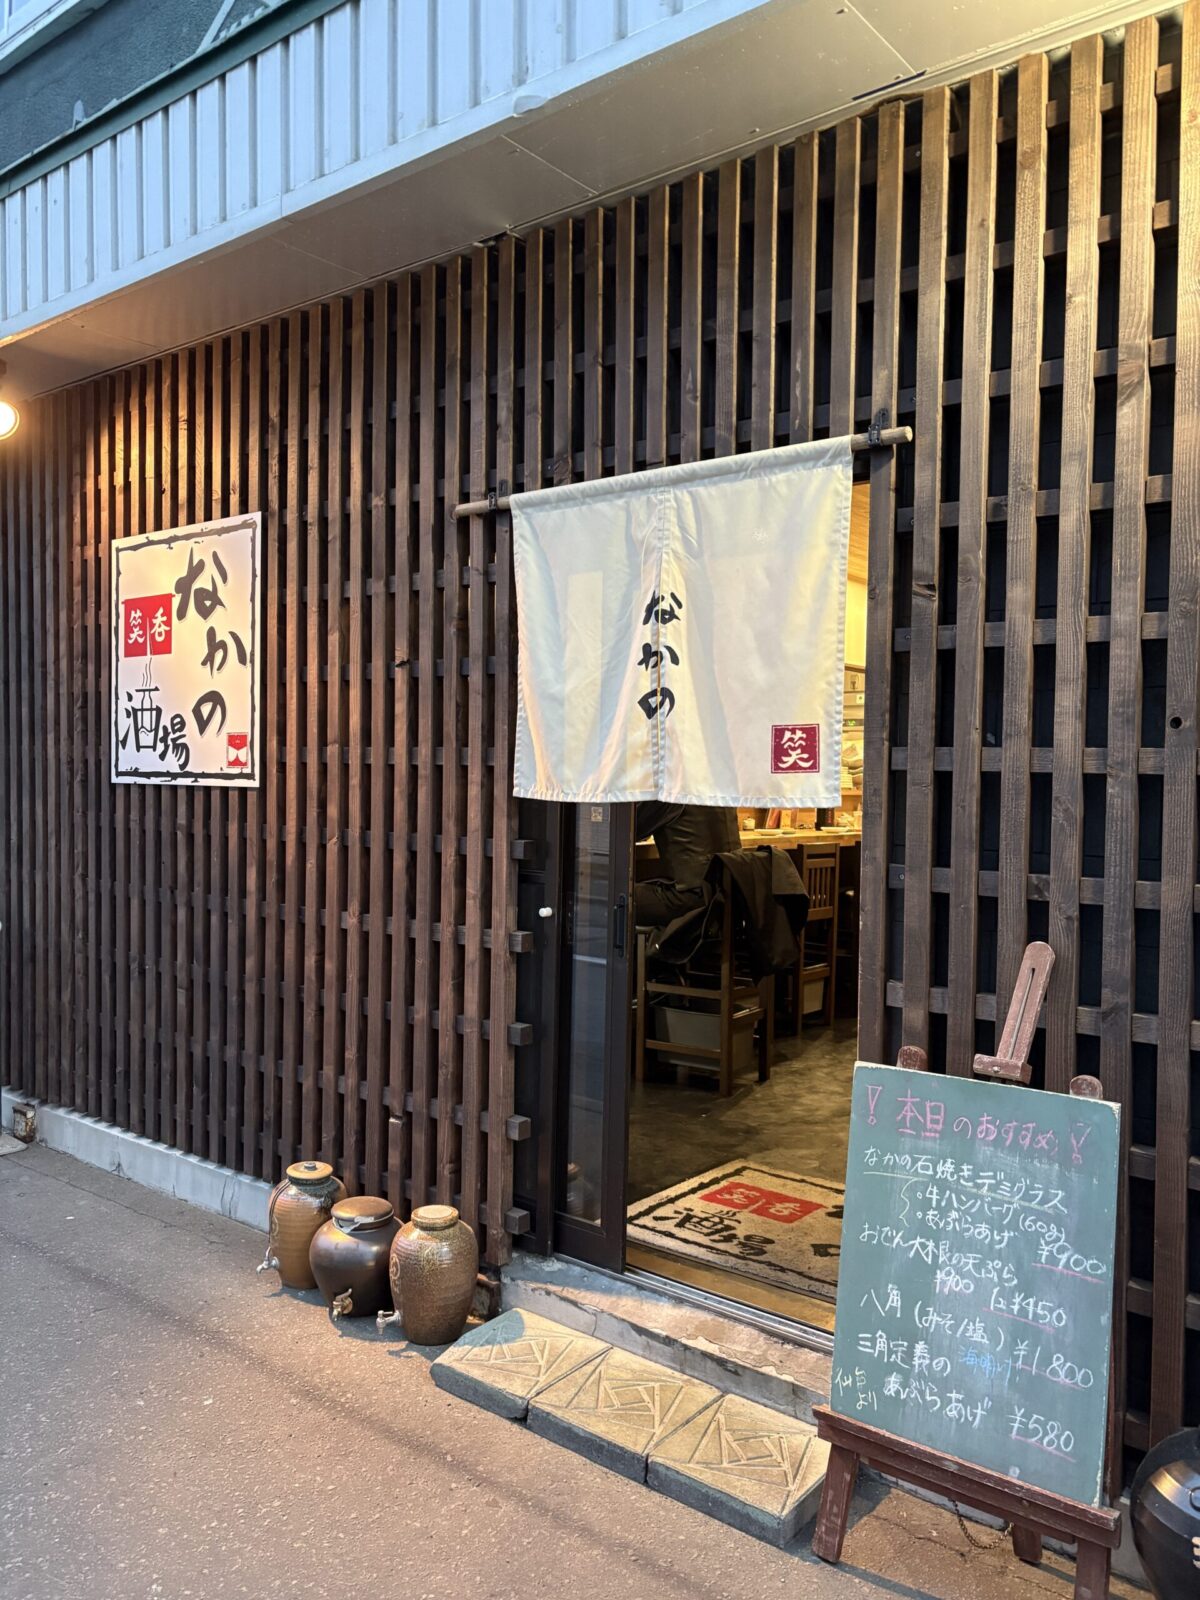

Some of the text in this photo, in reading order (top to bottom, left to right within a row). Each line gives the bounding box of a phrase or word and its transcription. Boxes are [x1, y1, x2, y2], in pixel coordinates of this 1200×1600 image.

[174, 546, 248, 738] なかの
[637, 589, 683, 720] なかの
[119, 685, 190, 771] 酒場
[777, 728, 814, 769] 笑
[896, 1089, 1059, 1155] 本日のおすすめ
[864, 1145, 1068, 1214] なかの石焼きデミグラス
[925, 1208, 1107, 1274] あぶらあげ ¥900
[859, 1283, 902, 1318] 八角
[835, 1366, 867, 1397] 仙台
[856, 1390, 878, 1411] より
[883, 1371, 1075, 1452] あぶらあげ ¥580
